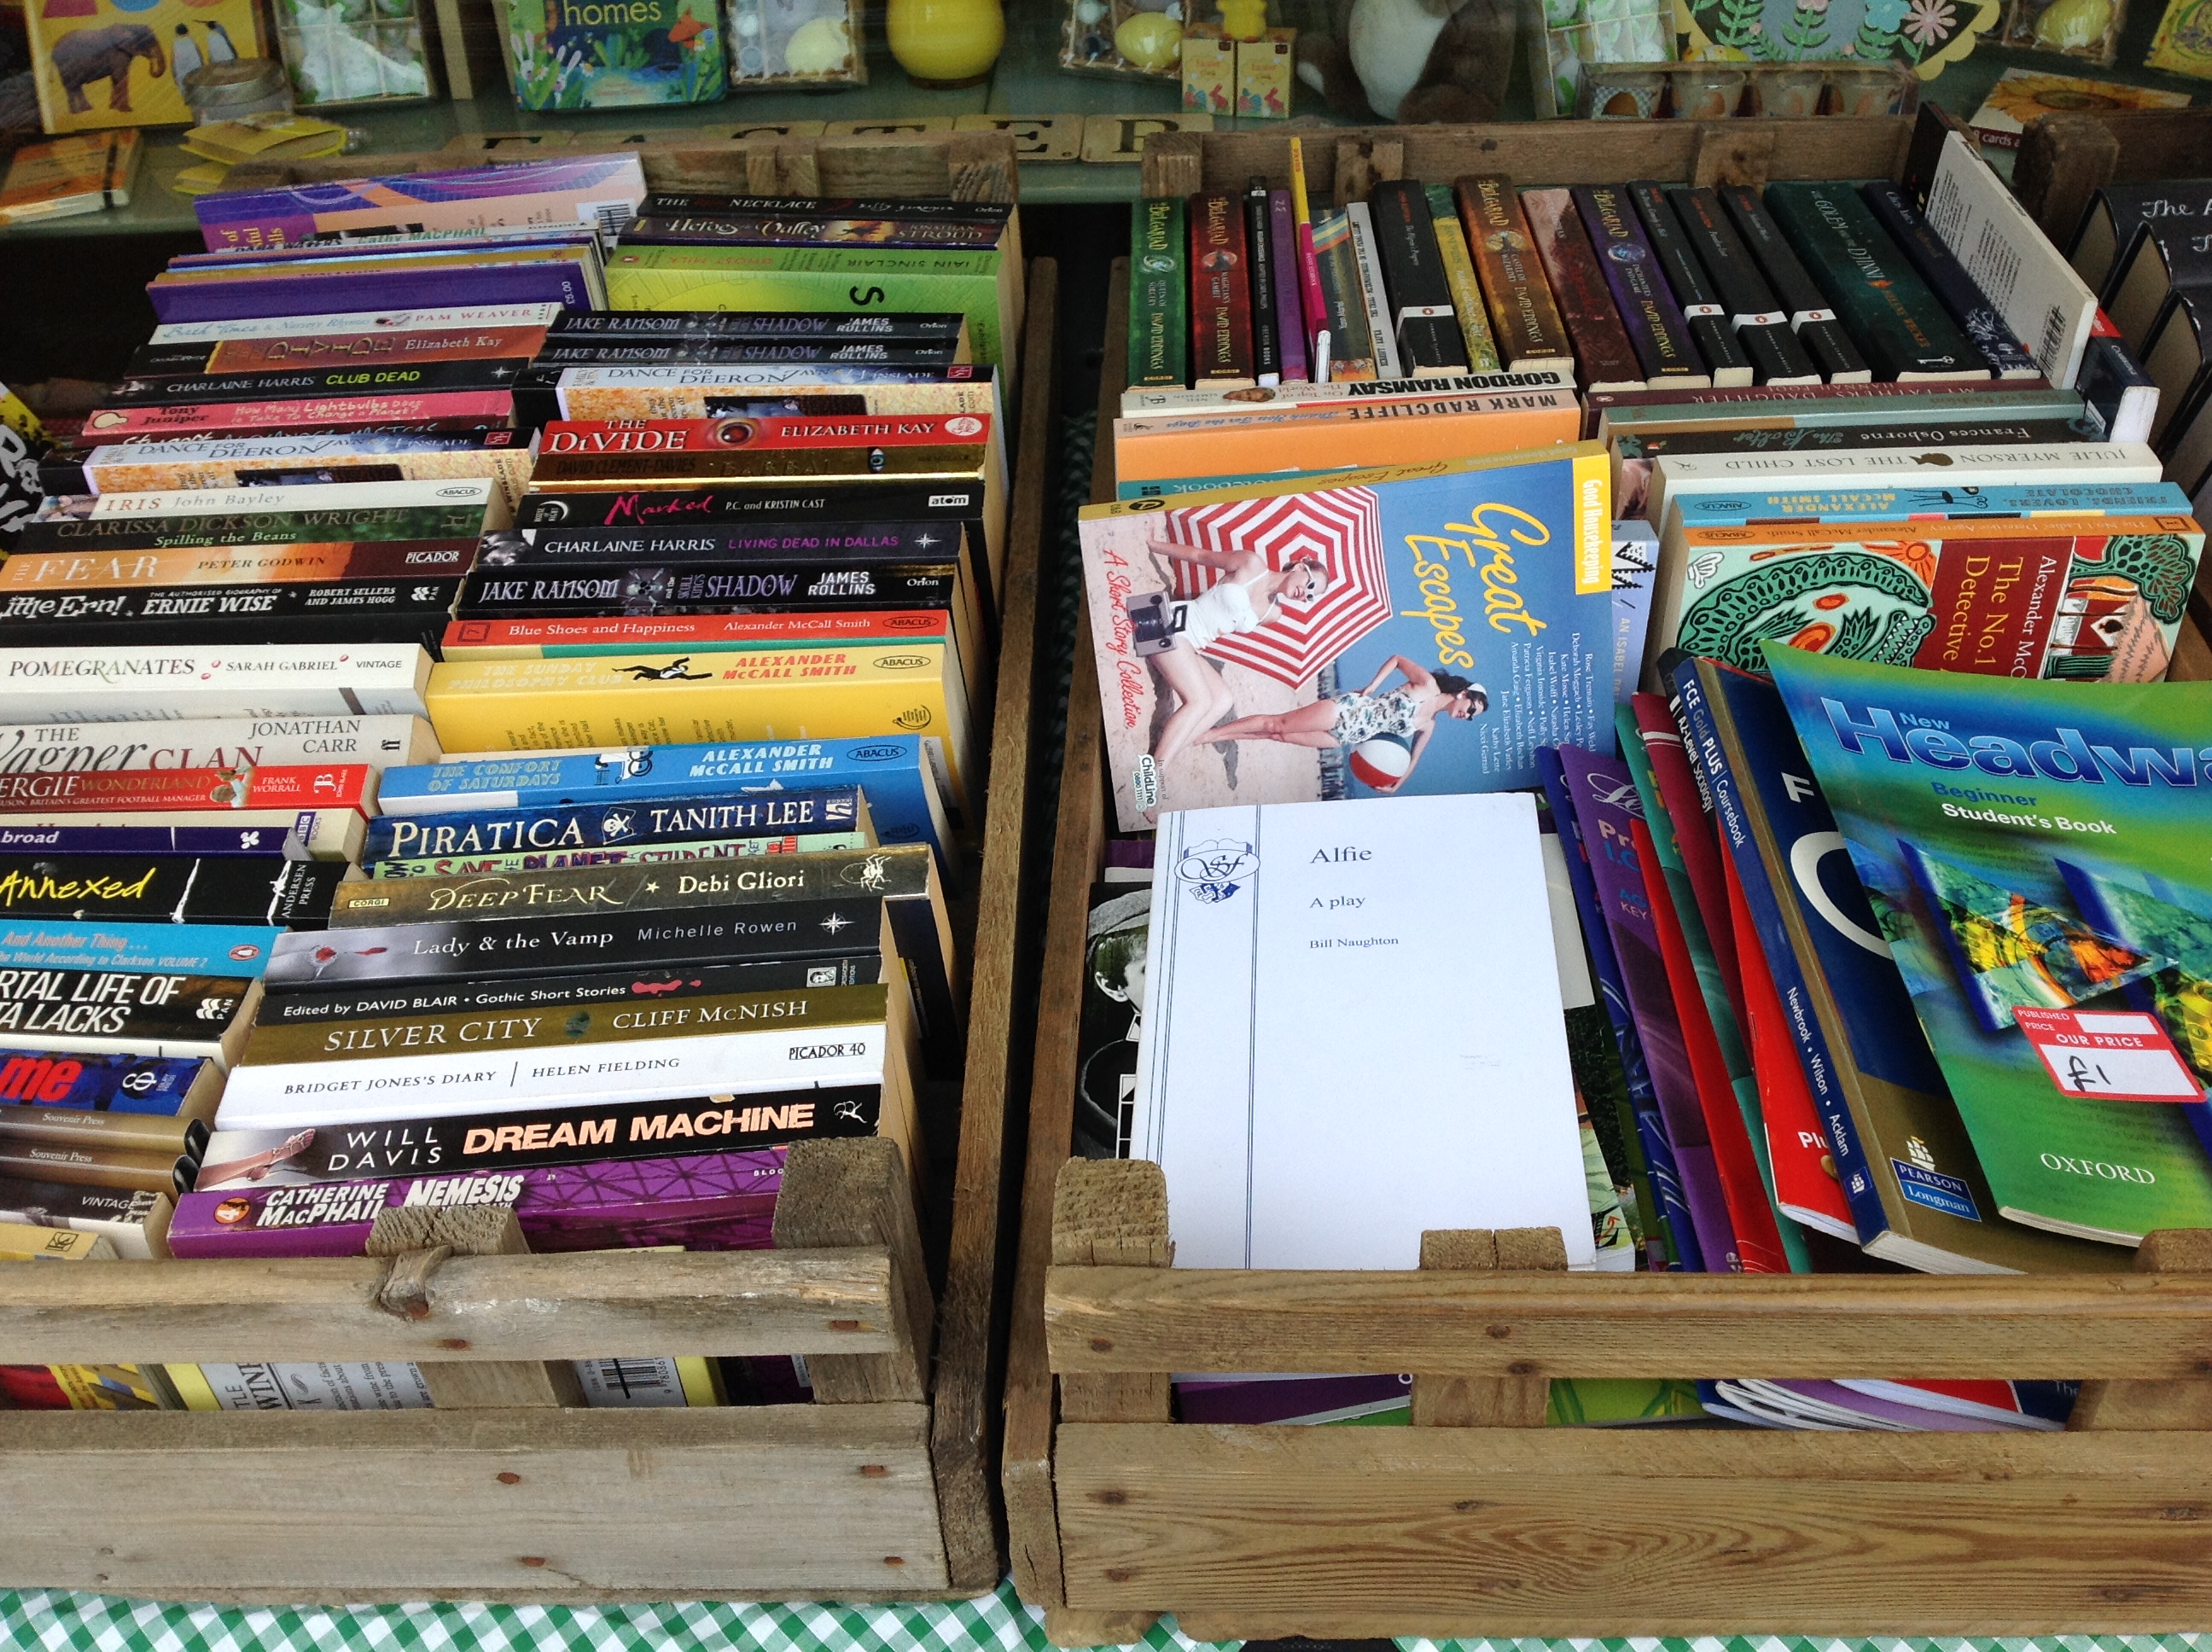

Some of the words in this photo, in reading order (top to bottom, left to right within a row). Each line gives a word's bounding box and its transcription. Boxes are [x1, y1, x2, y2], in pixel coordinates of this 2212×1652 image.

[563, 0, 663, 26] homes
[1982, 134, 2011, 146] cards
[656, 197, 690, 207] THE
[729, 199, 818, 210] NECKLACE
[1814, 200, 1848, 230] GOLEM
[2142, 199, 2193, 217] The
[898, 230, 983, 240] STROUD
[847, 259, 928, 269] SINCLAIR
[934, 259, 969, 269] IAIN
[1847, 247, 1886, 279] DJINNI
[415, 312, 453, 322] PAM
[461, 308, 533, 319] WEAVER
[1150, 312, 1164, 334] DAVID
[1215, 306, 1229, 329] DAVID
[1641, 299, 1660, 326] DAVID
[405, 338, 470, 351] Elizabeth
[475, 336, 504, 347] Kay
[1650, 326, 1676, 358] EDDINGS
[166, 378, 253, 393] CHARLAINE
[258, 375, 317, 388] HARRIS
[325, 373, 372, 385] CLUB
[375, 370, 421, 382] DEAD
[1348, 376, 1448, 396] RAMSAY
[1452, 370, 1562, 389] GORDON
[1347, 397, 1479, 420] RADCLIFFE
[1487, 393, 1557, 410] MARK
[781, 423, 890, 438] ELIZABETH
[897, 423, 936, 435] KAY
[1860, 429, 1946, 441] Osborne
[1952, 428, 2031, 439] Frances
[1726, 458, 1794, 469] CHILD
[1806, 457, 1855, 468] LOST
[1867, 456, 1907, 466] THE
[1959, 451, 2060, 464] MYERSON
[2073, 448, 2126, 461] JULIE
[104, 497, 163, 511] IRIS
[172, 496, 216, 508] John
[224, 492, 285, 506] Bayley
[1581, 479, 1603, 507] Good
[154, 534, 214, 548] Spilling
[220, 532, 246, 543] the
[250, 531, 297, 542] Beans
[544, 540, 644, 554] CHARLAINE
[649, 538, 716, 552] HARRIS
[727, 538, 778, 549] LIVING
[782, 537, 820, 548] DEAD
[824, 537, 841, 547] IN
[844, 535, 899, 547] DALLAS
[1580, 508, 1601, 586] Housekeeping
[405, 550, 461, 563] PICADOR
[1103, 549, 1128, 568] A
[817, 571, 870, 585] JAMES
[1444, 502, 1551, 637] Great
[1997, 555, 2026, 603] The
[705, 573, 799, 598] SHADOW
[807, 583, 876, 596] ROLLINS
[1106, 569, 1132, 618] Short
[140, 597, 214, 615] ERNIE
[218, 595, 278, 614] WISE
[1400, 534, 1476, 670] Escapes
[1942, 554, 1992, 661] Detective
[509, 625, 542, 636] Blue
[546, 624, 588, 635] Shoes
[592, 624, 619, 634] and
[622, 622, 696, 637] Happiness
[724, 620, 784, 631] Alexander
[788, 620, 831, 630] McCall
[835, 618, 870, 629] Smith
[891, 618, 932, 626] ABACUS
[1106, 614, 1138, 655] Story
[1974, 609, 2007, 666] No.1
[9, 659, 195, 683] POMEGRANATES
[225, 661, 276, 672] SARAH
[278, 660, 338, 672] GABRIEL
[736, 654, 847, 667] ALEXANDER
[1116, 659, 1144, 730] Collection
[1682, 678, 1701, 710] FCE
[247, 719, 361, 740] JONATHAN
[1691, 710, 1708, 740] Gold
[1899, 712, 1950, 730] New
[35, 727, 80, 742] THE
[302, 738, 358, 753] CARR
[1819, 695, 2212, 788] Headw
[701, 744, 823, 763] ALEXANDER
[1705, 736, 1723, 777] PLUS
[1678, 717, 1698, 765] A2-Level
[1692, 762, 1714, 814] Sociology
[0, 775, 80, 798] ERGIE
[79, 775, 211, 792] WONDERLAND
[253, 783, 302, 794] WORRALL
[261, 776, 297, 785] FRANK
[1141, 756, 1155, 805] ChildLine
[1930, 781, 2037, 807] Beginner
[1716, 778, 1746, 850] Coursebook
[1941, 801, 2052, 829] Student's
[2057, 816, 2117, 835] Book
[387, 817, 585, 858] PIRATICA
[650, 802, 757, 834] TANITH
[765, 800, 814, 825] LEE
[1309, 846, 1373, 864] Alfie
[282, 864, 307, 919] ANDERSEN
[299, 876, 317, 905] PRESS
[428, 877, 519, 911] DEEP
[522, 882, 624, 906] FEAR
[678, 874, 730, 894] Debi
[736, 870, 805, 890] Gliori
[1309, 897, 1324, 908] A
[1330, 895, 1366, 910] play
[1619, 900, 1649, 921] KEY
[413, 936, 470, 957] Lady
[479, 936, 498, 951] &
[506, 934, 540, 949] the
[550, 930, 614, 948] Vamp
[637, 923, 725, 940] Michelle
[734, 919, 797, 935] Rowen
[1309, 939, 1333, 949] Bill
[1337, 937, 1400, 949] Naughton
[70, 973, 142, 1005] LIFE
[138, 975, 187, 1005] OF
[282, 1005, 329, 1016] Edited
[334, 1003, 351, 1015] by
[356, 999, 407, 1012] DAVID
[413, 996, 457, 1009] BLAIR
[475, 992, 525, 1005] Gothic
[530, 989, 571, 1001] Short
[575, 985, 626, 998] Stories
[23, 1003, 132, 1034] LACKS
[2017, 1009, 2070, 1021] PUBLISHED
[2024, 1021, 2056, 1032] PRICE
[2056, 1033, 2090, 1045] OUR
[2093, 1035, 2144, 1048] PRICE
[284, 1080, 363, 1095] BRIDGET
[364, 1075, 436, 1091] JONES'S
[442, 1070, 497, 1084] DIARY
[532, 1064, 591, 1079] HELEN
[597, 1058, 681, 1073] FIELDING
[1786, 986, 1812, 1044] Newbrook
[1809, 1052, 1829, 1096] Wilson
[1829, 1113, 1849, 1157] Acklam
[2067, 1055, 2111, 1092] £1
[42, 1113, 82, 1124] Souvenir
[82, 1115, 106, 1126] Press
[463, 1118, 618, 1155] DREAM
[629, 1102, 816, 1141] MACHINE
[346, 1126, 439, 1149] WILL
[328, 1147, 443, 1172] DAVIS
[2039, 1152, 2156, 1184] OXFORD
[403, 1173, 525, 1207] NEMESIS
[1899, 1165, 1962, 1192] PEARSON
[82, 1195, 138, 1210] VINTAGE
[265, 1183, 390, 1207] CATHERINE
[1907, 1184, 1970, 1213] Longman
